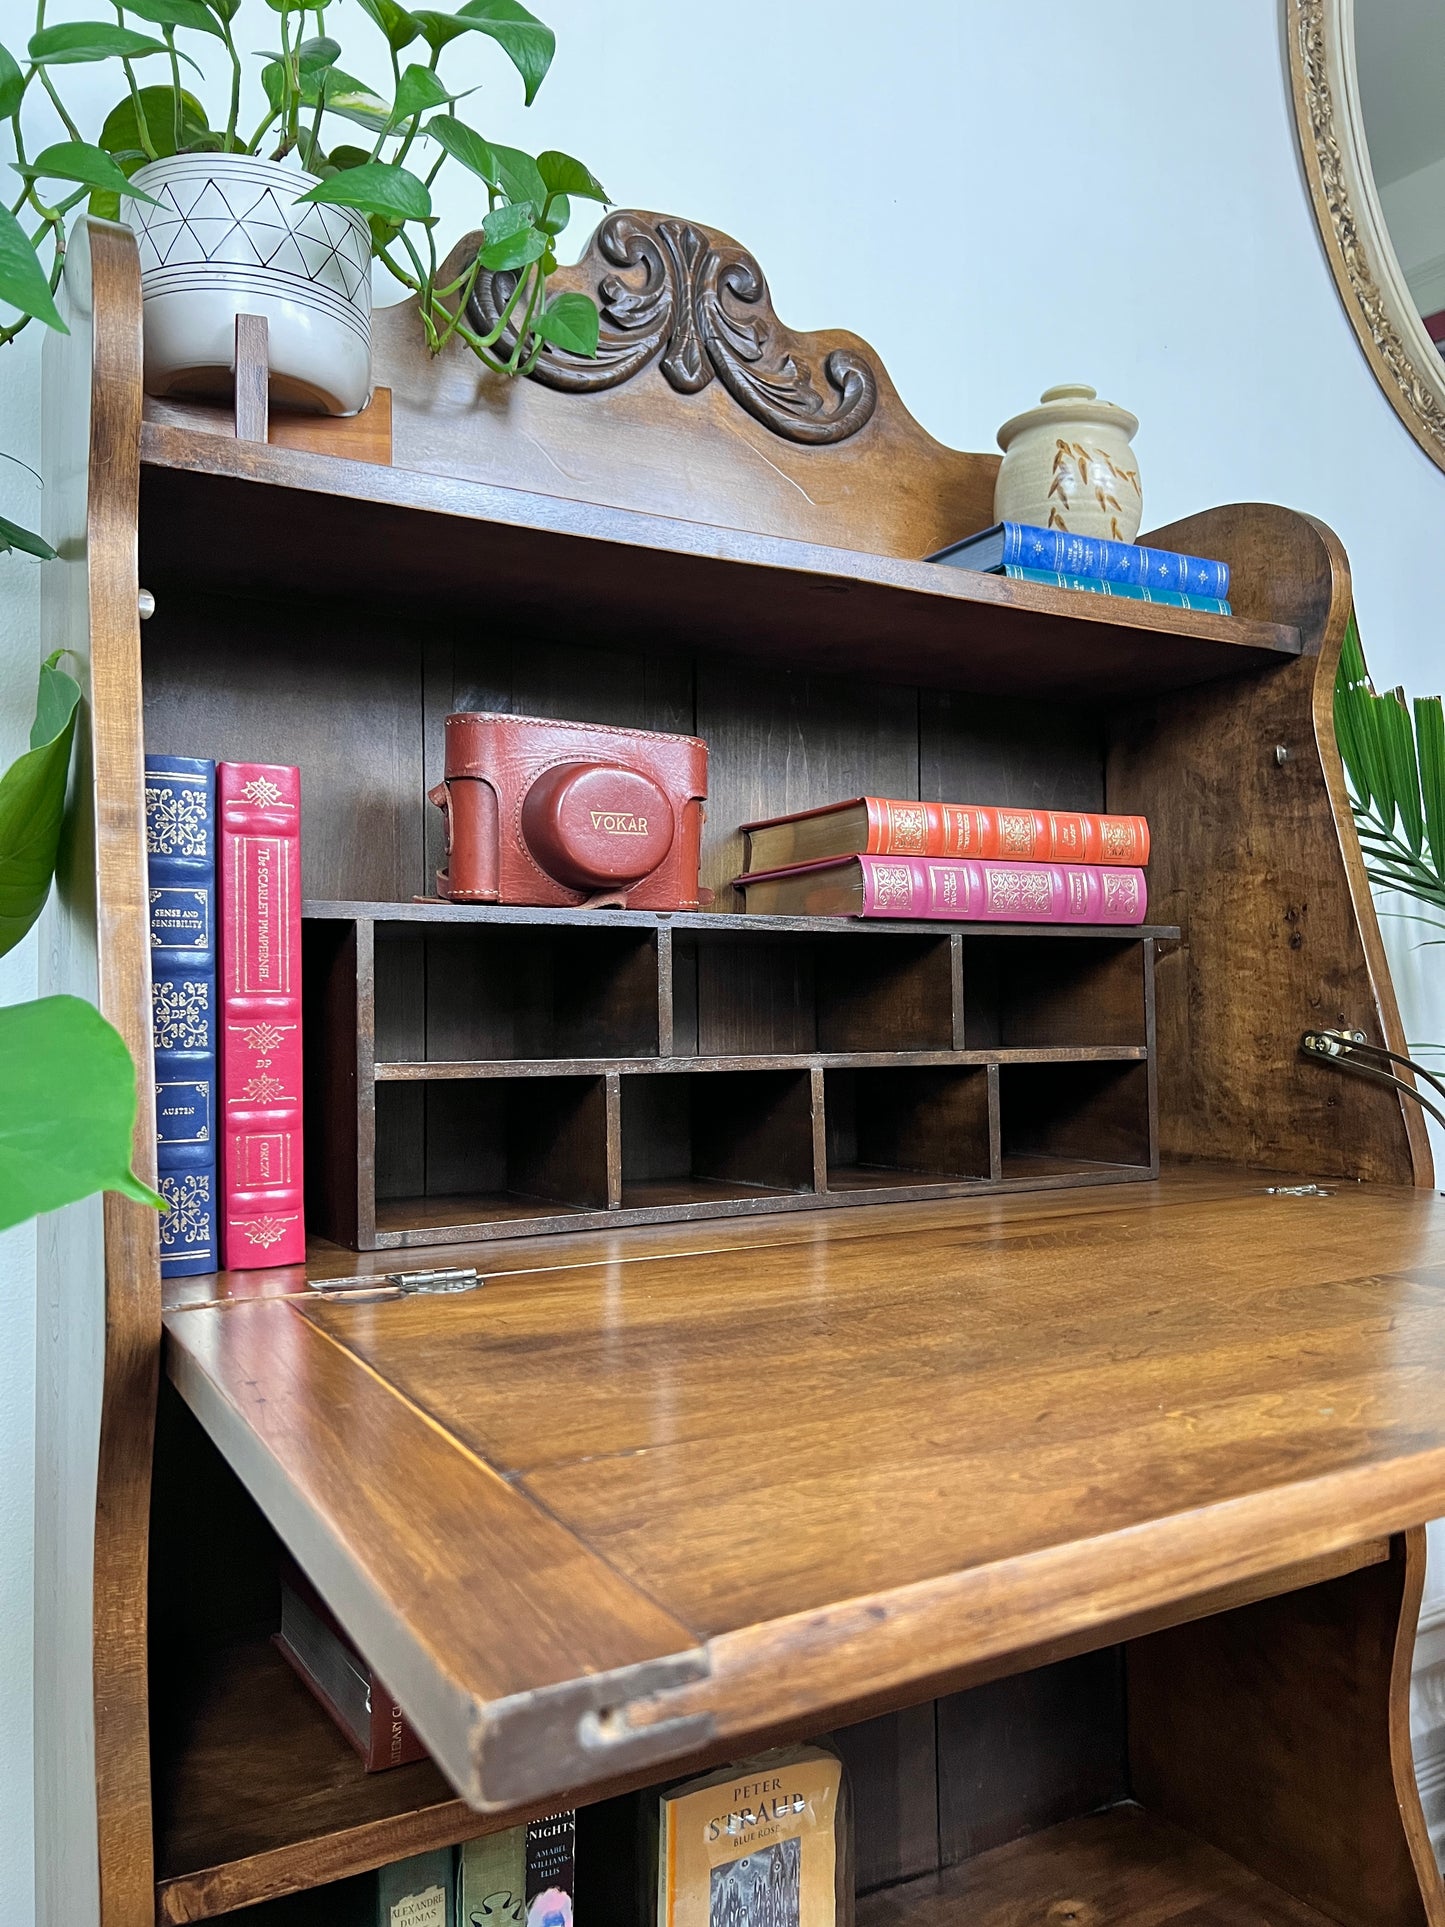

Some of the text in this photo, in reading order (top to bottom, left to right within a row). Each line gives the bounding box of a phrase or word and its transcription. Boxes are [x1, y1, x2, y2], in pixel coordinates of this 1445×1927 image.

[590, 812, 649, 835] VOKAR
[151, 919, 203, 929] SENSIBILITY
[154, 909, 199, 918] SENSE AND
[258, 848, 271, 982] The SCARLET PIMPERNEL
[162, 1106, 195, 1116] AUSTEN
[259, 1141, 270, 1179] ORCZY
[391, 1721, 402, 1764] LITERARY
[734, 1778, 783, 1802] PETER
[709, 1793, 806, 1842] STRAUB
[529, 1821, 576, 1841] NIGHTS
[733, 1824, 781, 1848] BLUE ROSE
[535, 1844, 567, 1859] AMABEL
[530, 1855, 572, 1870] WILLIAMS-
[540, 1867, 561, 1879] ELLIS
[392, 1892, 444, 1919] ALEXANDRE
[400, 1908, 437, 1927] DUMAS
